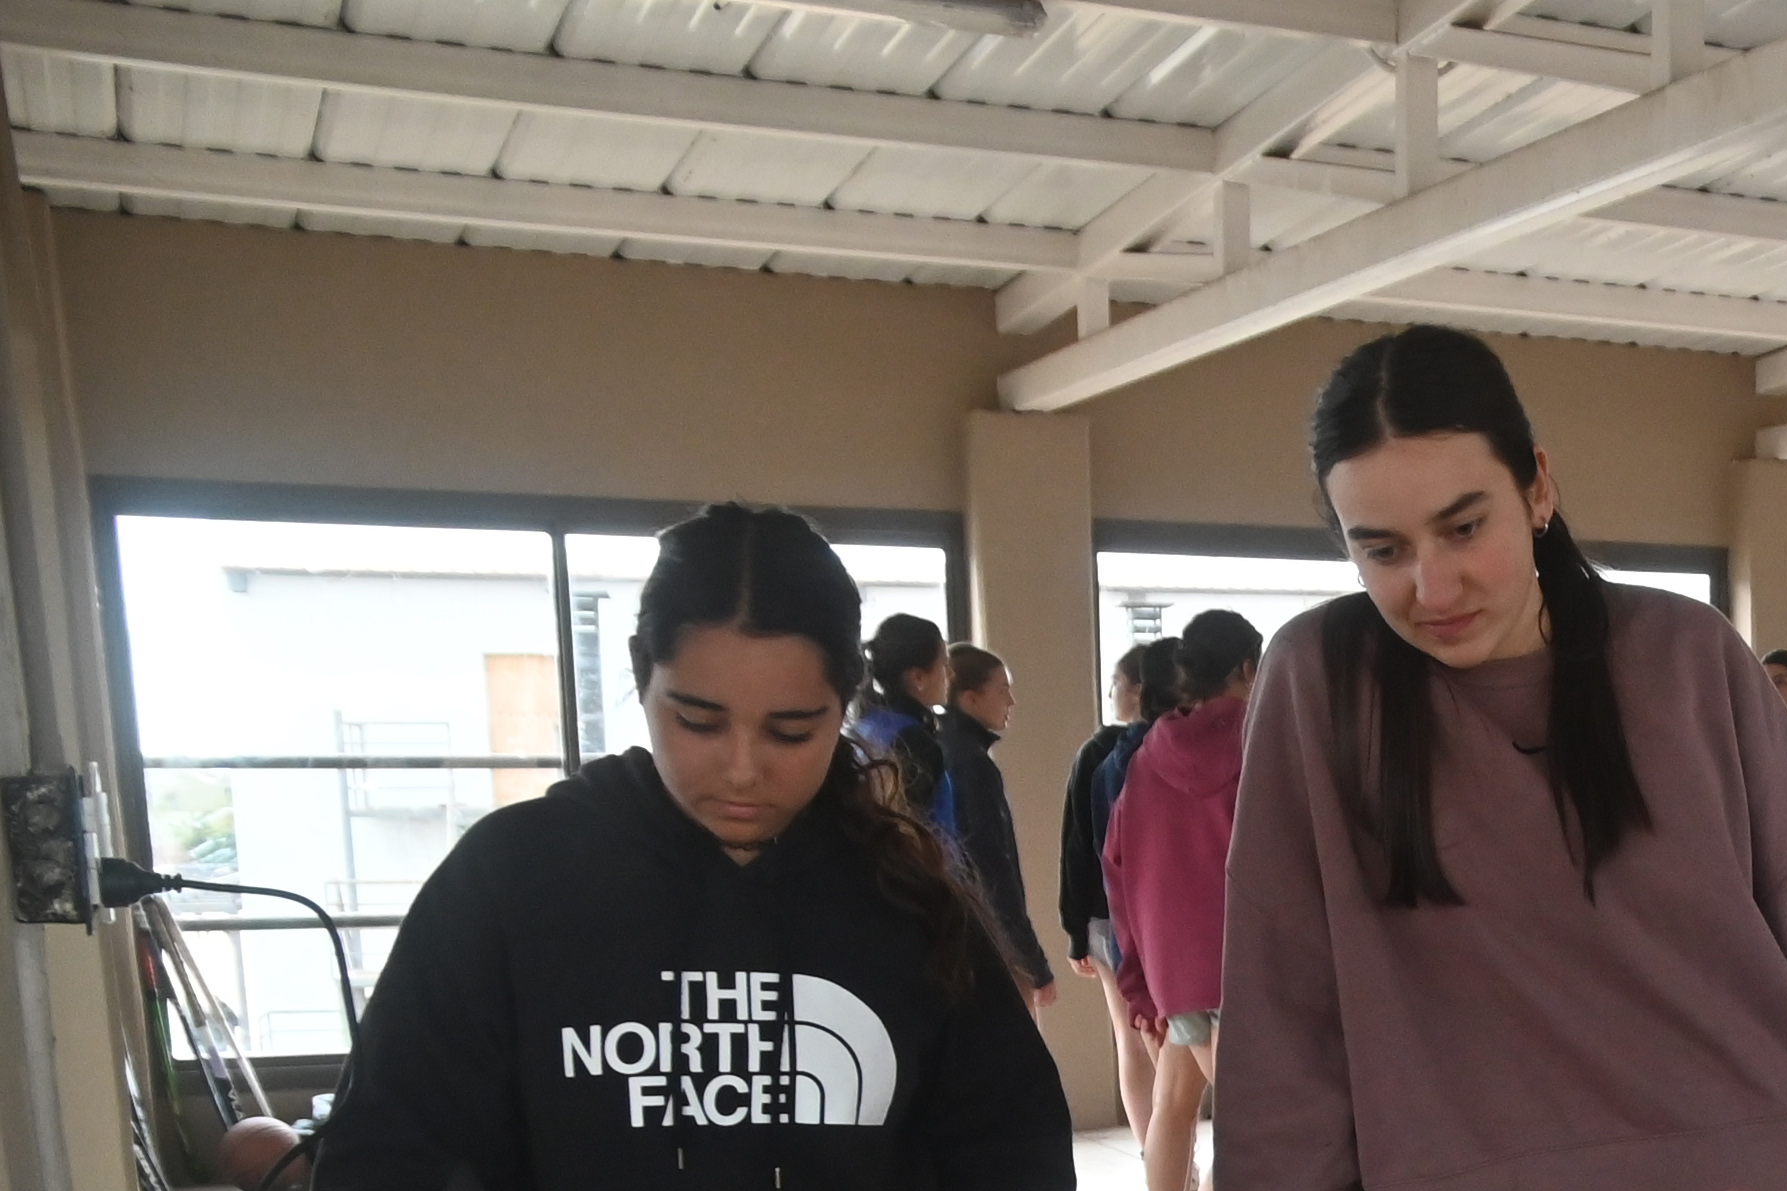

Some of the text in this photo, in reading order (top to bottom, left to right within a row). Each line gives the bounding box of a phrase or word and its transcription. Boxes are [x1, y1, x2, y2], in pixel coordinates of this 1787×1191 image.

[661, 971, 780, 1020] THE
[561, 1021, 790, 1077] NORTH
[628, 1074, 789, 1127] FACE
